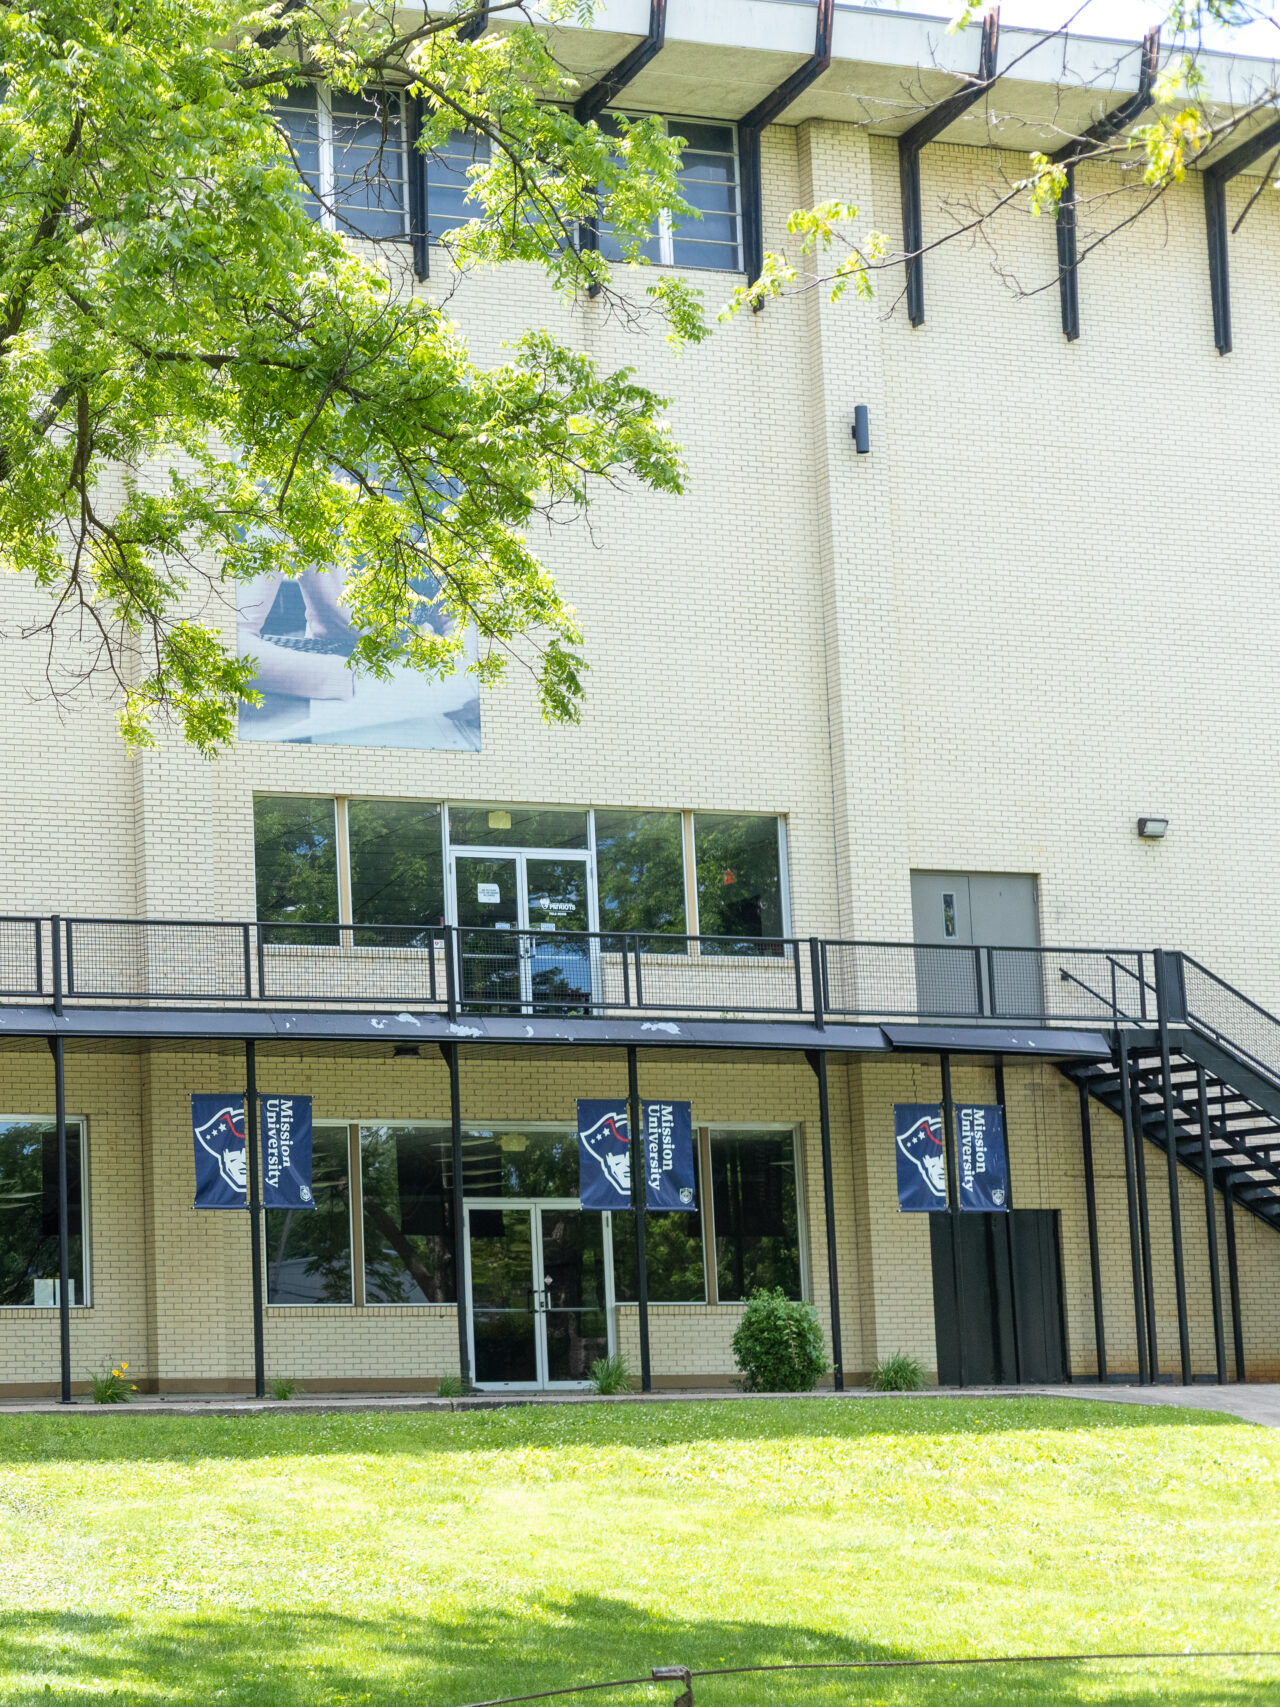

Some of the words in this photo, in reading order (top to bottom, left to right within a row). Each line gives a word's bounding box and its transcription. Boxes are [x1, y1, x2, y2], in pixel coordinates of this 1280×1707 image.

[265, 1099, 283, 1188] University
[280, 1099, 294, 1167] Mission
[648, 1104, 662, 1191] University
[661, 1104, 676, 1171] Mission
[961, 1108, 976, 1192] University
[973, 1108, 988, 1173] Mission
